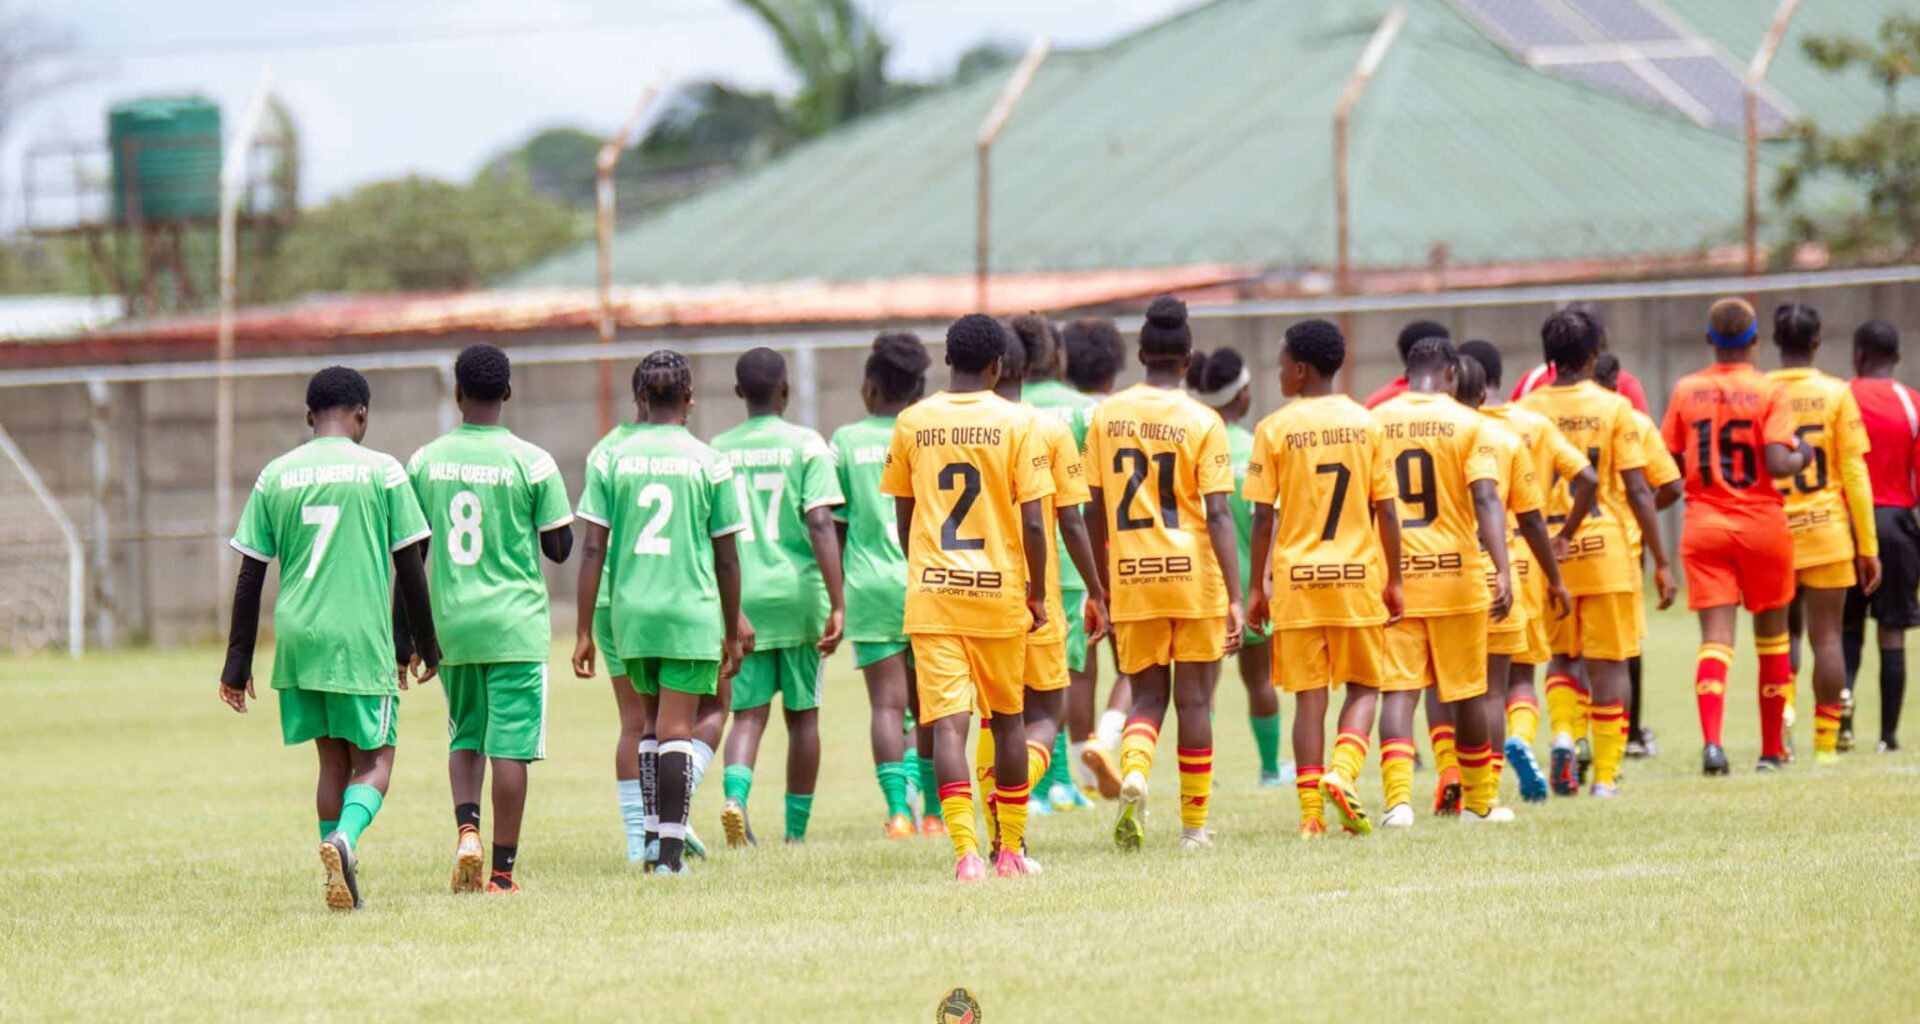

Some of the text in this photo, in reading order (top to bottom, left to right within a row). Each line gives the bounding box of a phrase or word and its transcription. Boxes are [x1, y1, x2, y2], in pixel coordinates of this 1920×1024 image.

[951, 427, 1002, 446] QUEENS
[1140, 422, 1186, 443] QUEENS
[1322, 427, 1366, 446] QUEENS
[1409, 421, 1455, 438] QUEENS
[1691, 418, 1756, 488] 16
[315, 464, 357, 485] QUEENS
[357, 465, 372, 484] FC
[461, 463, 500, 485] QUEENS
[501, 466, 515, 488] FC
[1113, 448, 1179, 531] 21
[1395, 448, 1438, 528] 9
[734, 473, 786, 542] 17
[938, 462, 985, 550] 2
[1316, 462, 1350, 541] 7
[447, 491, 484, 566] 8
[634, 483, 673, 555] 2
[302, 505, 340, 579] 7
[922, 567, 1002, 588] GSB
[1118, 556, 1191, 576] GSB
[1290, 564, 1366, 582] GSB
[937, 587, 965, 597] SPORT
[968, 590, 1002, 599] BETTING
